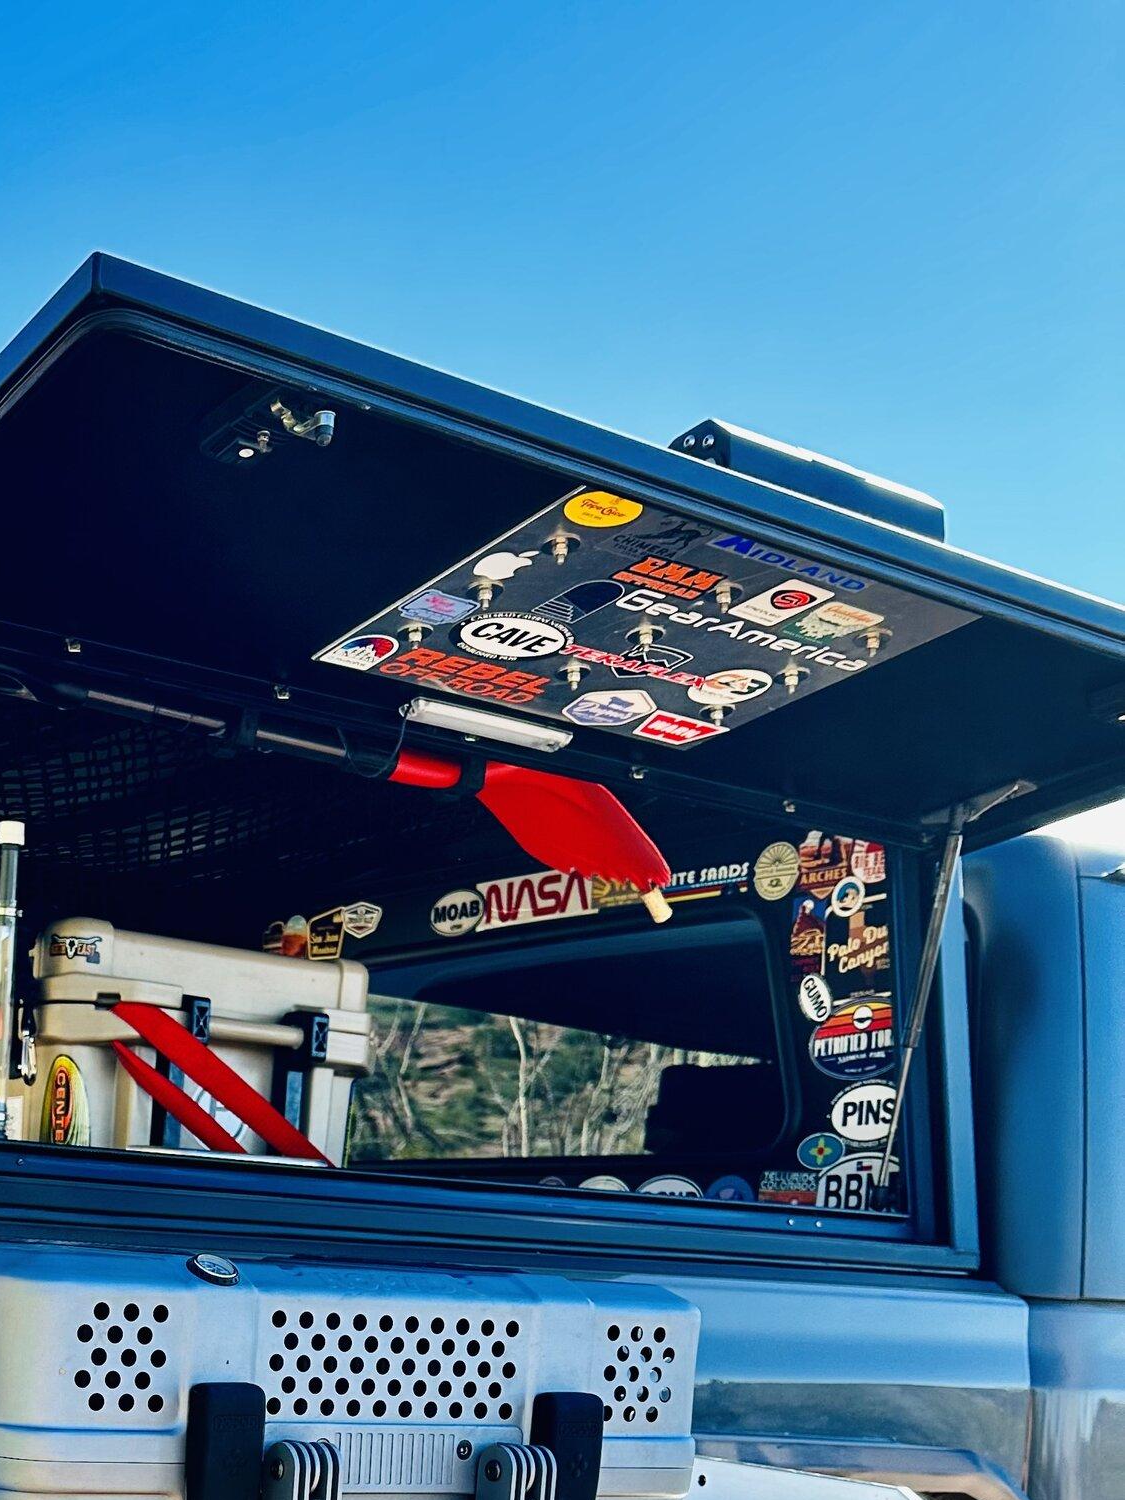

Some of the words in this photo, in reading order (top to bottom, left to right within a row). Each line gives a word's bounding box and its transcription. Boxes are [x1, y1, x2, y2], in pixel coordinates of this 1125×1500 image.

[714, 535, 866, 590] MIDLAND
[471, 623, 559, 653] CAVE
[395, 647, 551, 695] REBEL
[559, 644, 706, 689] TERAFLEX
[433, 901, 480, 924] MOAB
[486, 869, 589, 924] NASA
[700, 862, 751, 882] SANDS
[801, 867, 847, 884] ARCHES
[828, 937, 861, 961] Palo
[803, 977, 828, 1019] GUMO
[842, 1098, 896, 1127] PINS
